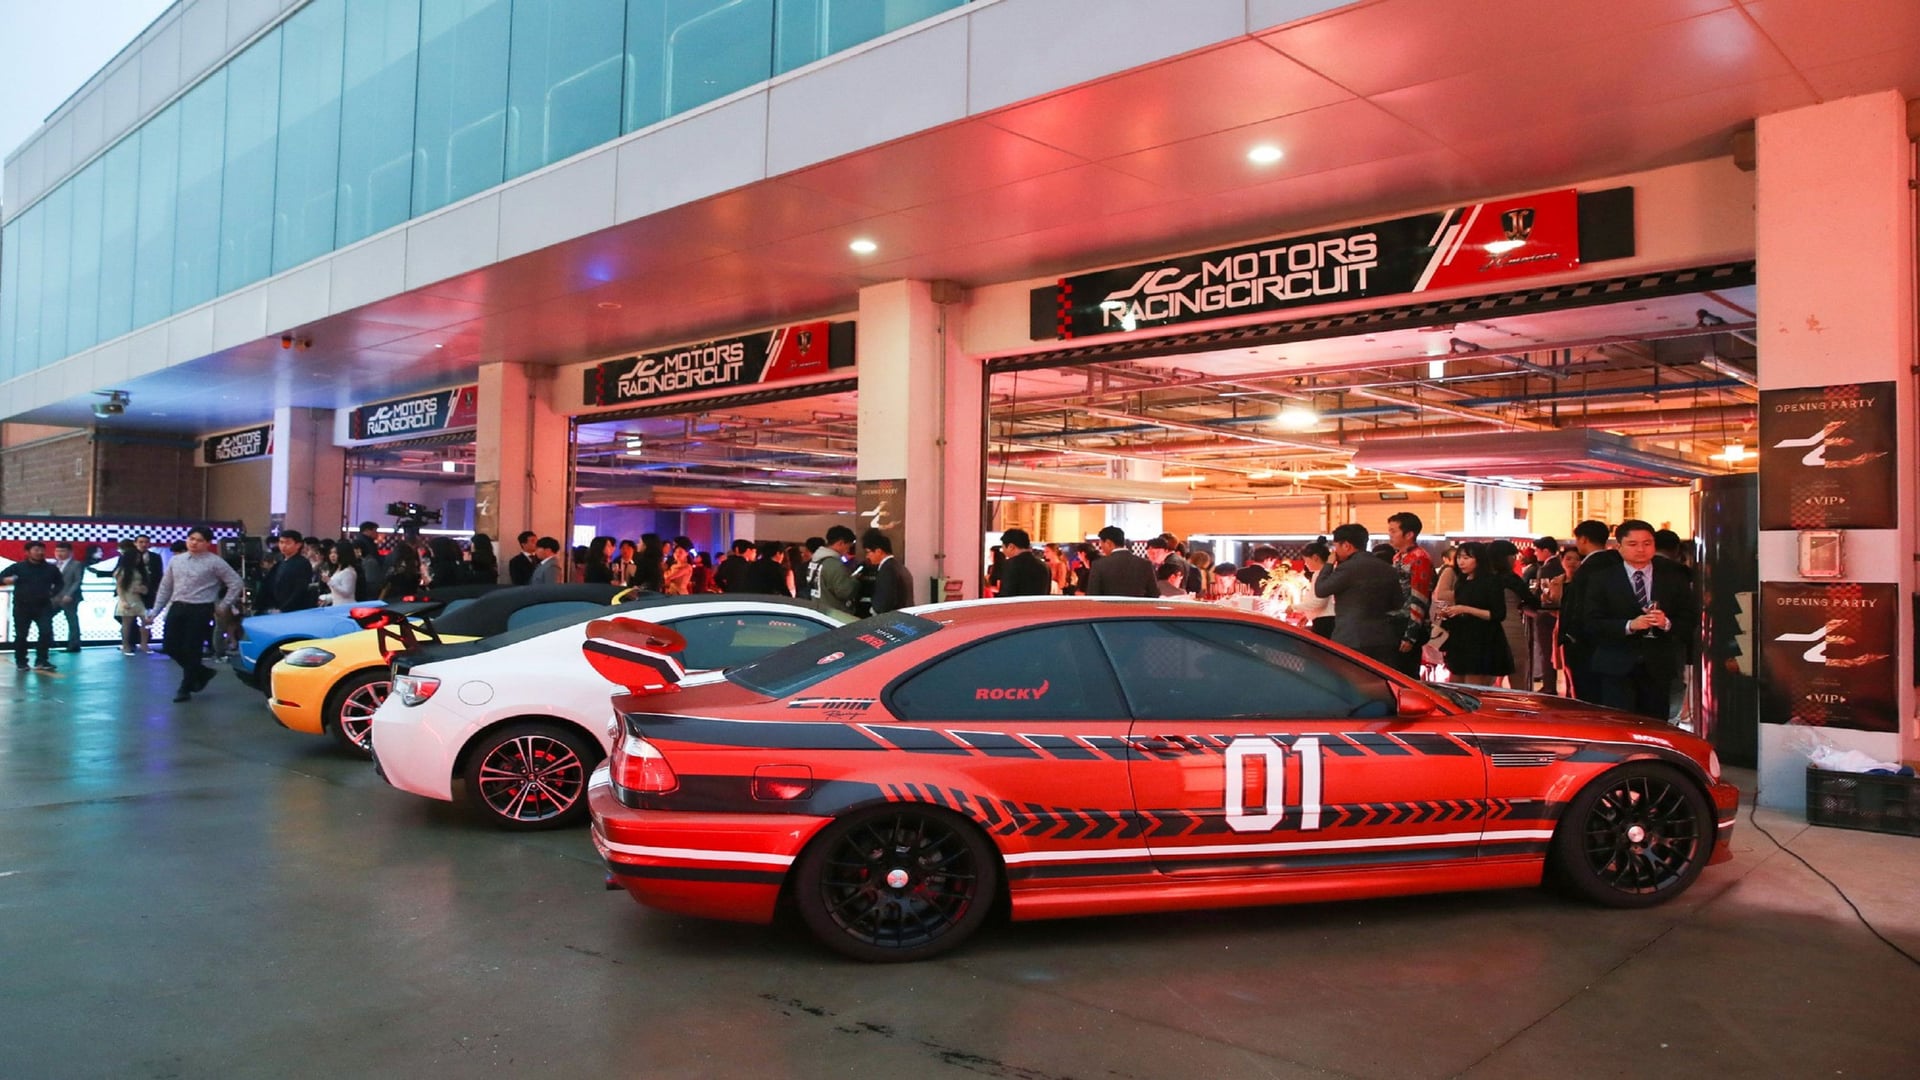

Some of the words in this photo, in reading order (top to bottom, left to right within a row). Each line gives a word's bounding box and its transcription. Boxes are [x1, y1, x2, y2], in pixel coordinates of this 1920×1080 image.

[1202, 232, 1378, 286] MOTORS
[1100, 261, 1378, 327] RACINGCIRCUIT
[664, 343, 744, 373] MOTORS
[618, 361, 743, 398] RACINGCIRCUIT
[393, 397, 437, 417] MOTORS
[1775, 401, 1828, 413] OPENING
[1831, 398, 1876, 410] PARTY
[1813, 496, 1838, 505] VIP
[1777, 597, 1828, 607] OPENING
[1832, 598, 1878, 608] PARTY
[976, 680, 1049, 700] ROCKY
[1814, 693, 1839, 704] VIP
[1225, 738, 1320, 831] 01
